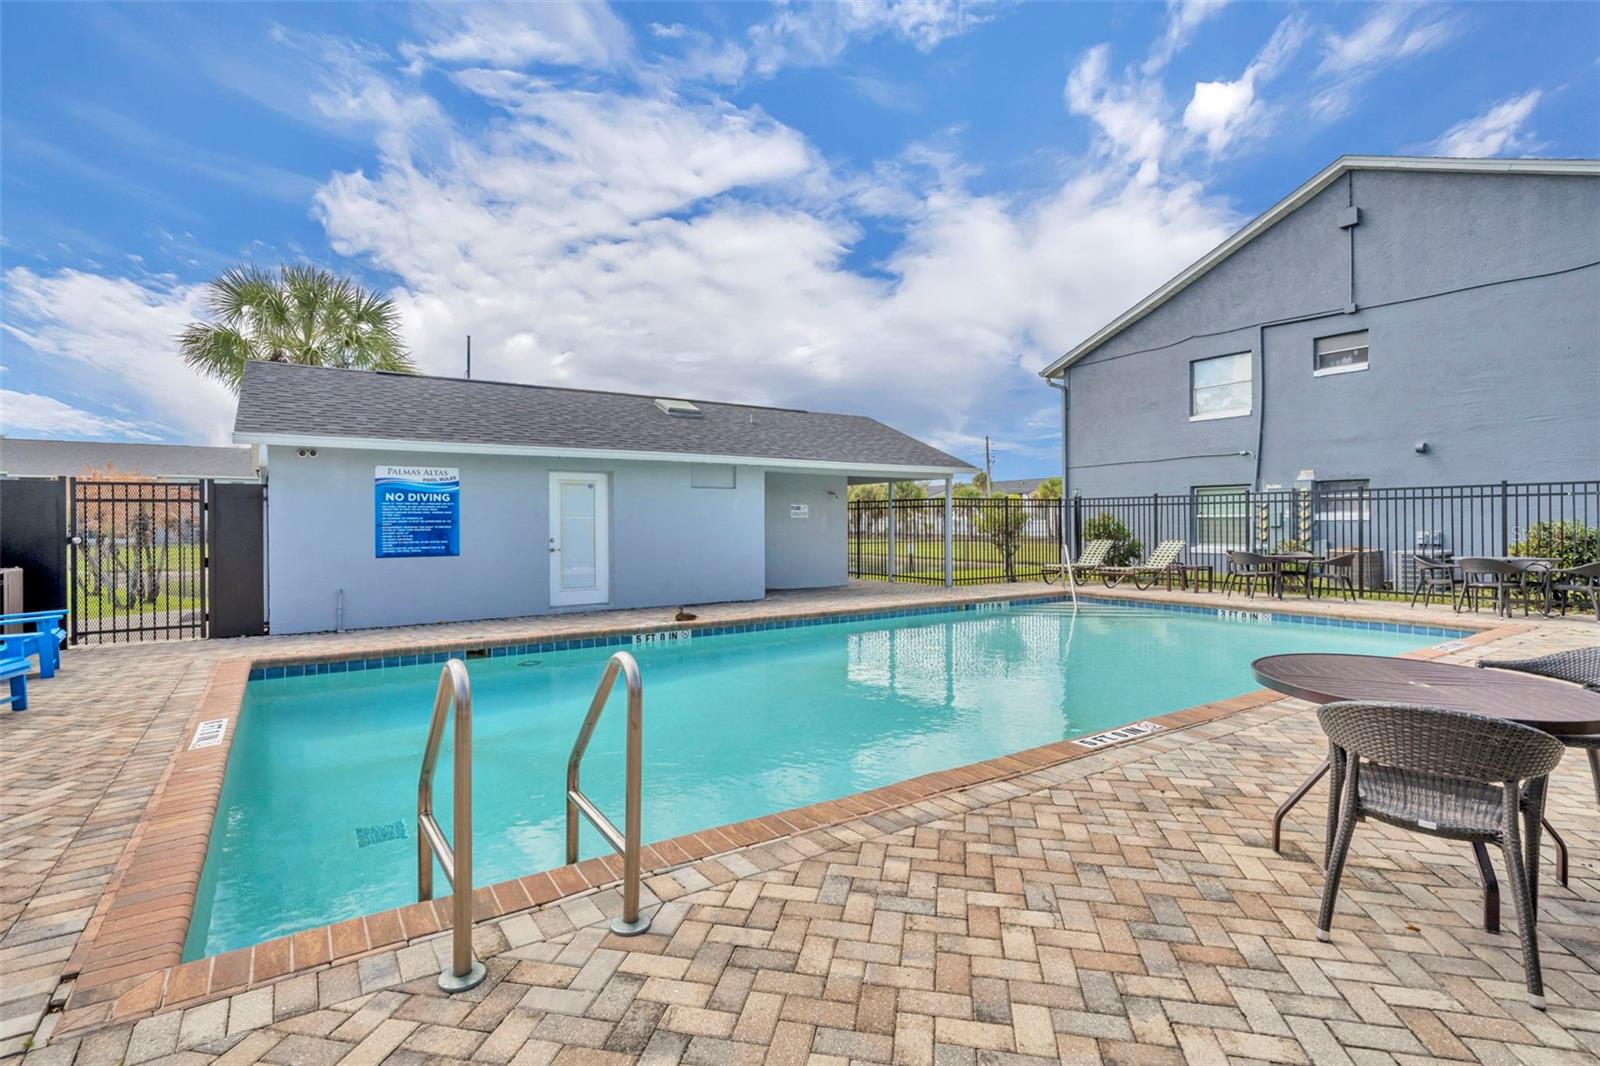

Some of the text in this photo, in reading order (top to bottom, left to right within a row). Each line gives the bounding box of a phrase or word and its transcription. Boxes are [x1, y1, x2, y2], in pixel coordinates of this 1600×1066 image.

[385, 493, 451, 502] NO DIVING
[636, 635, 641, 644] 5
[646, 633, 655, 642] FT
[669, 632, 677, 640] IN
[1091, 735, 1119, 744] FT
[1121, 727, 1146, 736] IN
